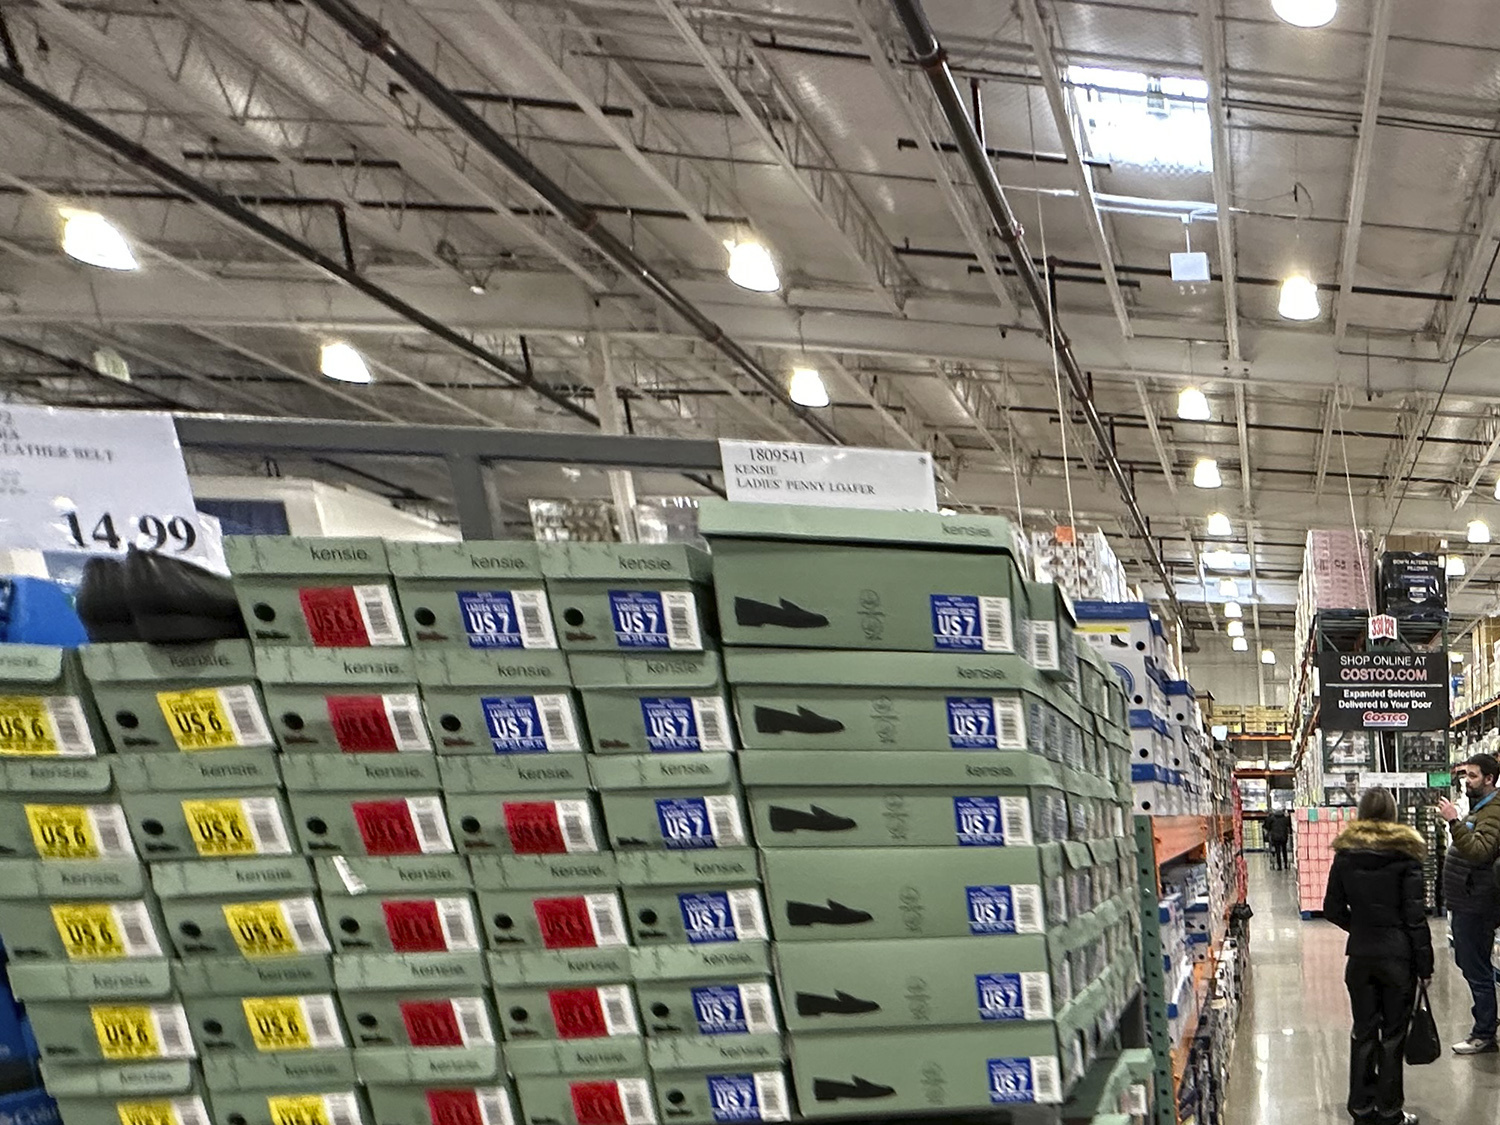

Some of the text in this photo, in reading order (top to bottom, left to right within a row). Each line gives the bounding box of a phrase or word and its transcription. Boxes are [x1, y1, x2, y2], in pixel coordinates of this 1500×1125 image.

[749, 447, 808, 464] 1809541
[733, 463, 778, 476] KENSIE
[786, 480, 826, 492] PENNY
[829, 483, 876, 495] LOAFER
[467, 612, 512, 634] US 7
[617, 611, 659, 634] US 7
[937, 614, 976, 637] US 7
[1340, 655, 1427, 667] SHOP ONLINE AT
[1340, 668, 1428, 681] COSTCO.COM
[1338, 700, 1433, 709] Delivered to Your Door
[1343, 689, 1427, 700] Expanded Selection
[175, 711, 222, 734] US 6
[493, 718, 536, 739] US 7
[650, 716, 689, 738] US 7
[953, 715, 990, 736] US 7
[198, 820, 243, 841] US 6
[665, 817, 704, 839] US 7
[961, 814, 998, 835] US 7
[41, 825, 70, 846] US
[688, 910, 714, 932] US
[973, 903, 997, 923] US
[66, 925, 97, 946] US
[983, 990, 1007, 1010] US
[699, 1002, 725, 1026] US
